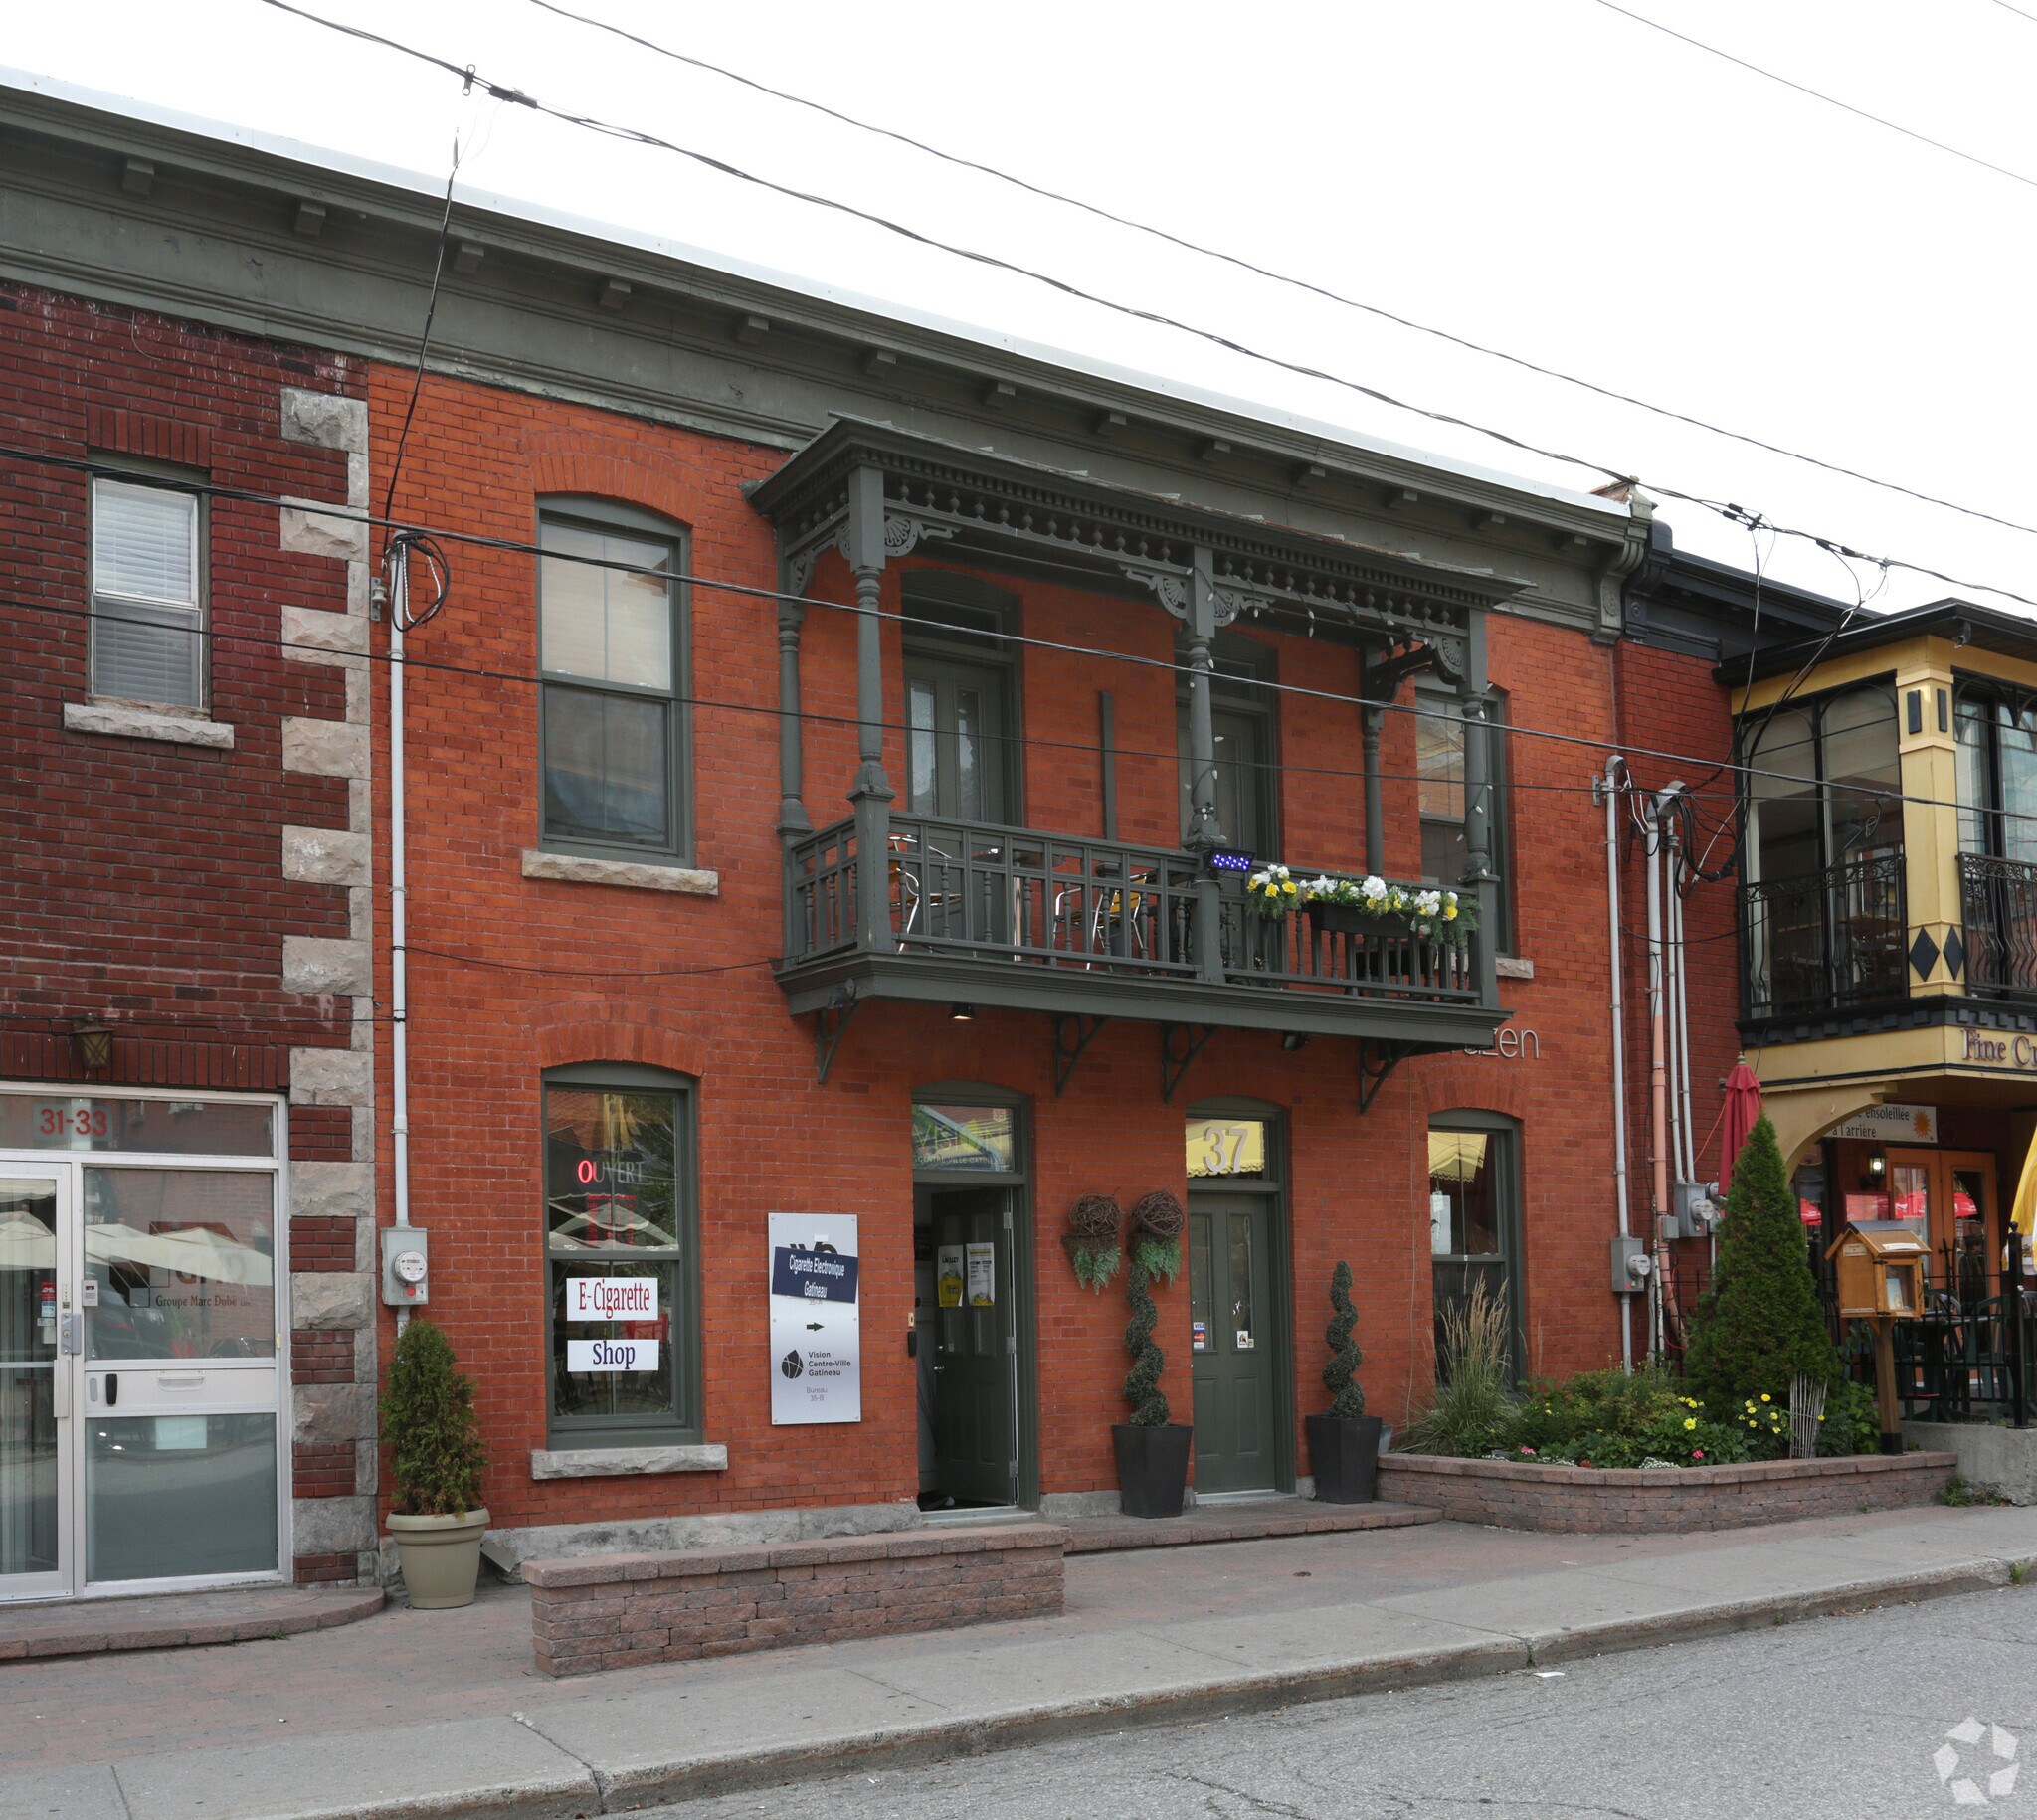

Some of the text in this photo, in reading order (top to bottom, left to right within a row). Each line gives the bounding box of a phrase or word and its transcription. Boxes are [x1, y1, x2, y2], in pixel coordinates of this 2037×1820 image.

[1961, 1027, 2007, 1062] Fine
[40, 1108, 108, 1137] 31-33
[1865, 1106, 1910, 1121] ensoleillée
[1840, 1123, 1877, 1138] l'arrière
[1203, 1127, 1248, 1174] 37
[577, 1159, 645, 1183] OUVERT
[789, 1254, 845, 1280] Cigarette Electronique
[155, 1294, 188, 1309] Groupe
[190, 1295, 212, 1307] Marc
[214, 1294, 237, 1307] Dubé
[579, 1279, 650, 1319] E-Cigarette
[804, 1280, 828, 1299] Gatineau
[592, 1340, 636, 1370] Shop
